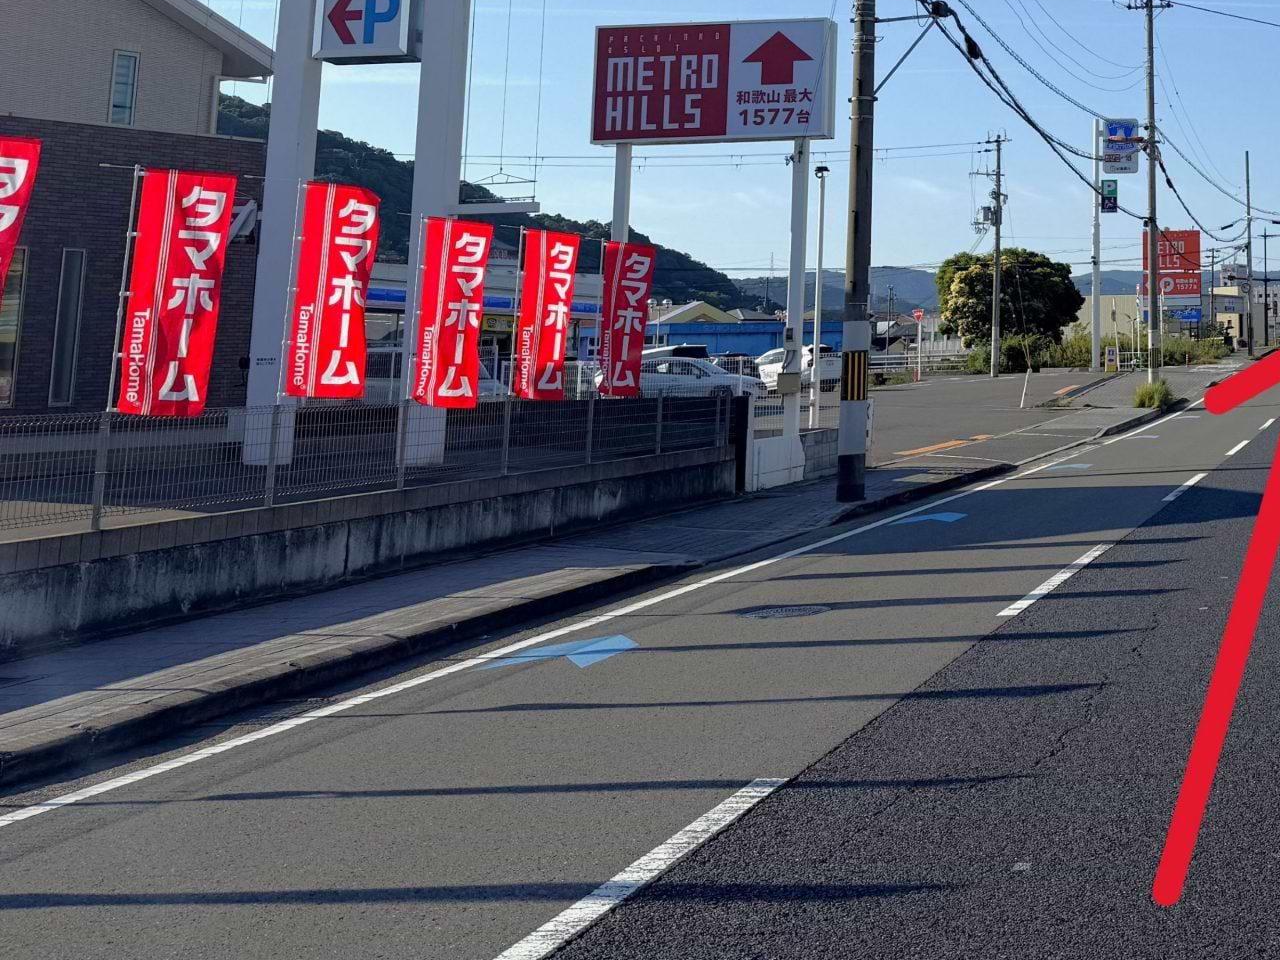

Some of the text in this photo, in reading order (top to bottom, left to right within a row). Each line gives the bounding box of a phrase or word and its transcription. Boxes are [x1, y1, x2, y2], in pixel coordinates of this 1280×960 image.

[605, 93, 701, 132] HILLS
[606, 54, 719, 92] METRO
[738, 107, 811, 126] 1577台
[1157, 241, 1185, 254] ETRO
[1159, 254, 1180, 267] LLS
[158, 186, 227, 402] タマホーム
[320, 199, 377, 385] タマホーム
[438, 232, 487, 398] タマホーム
[537, 242, 574, 390] タマホーム
[612, 253, 651, 387] タマホーム
